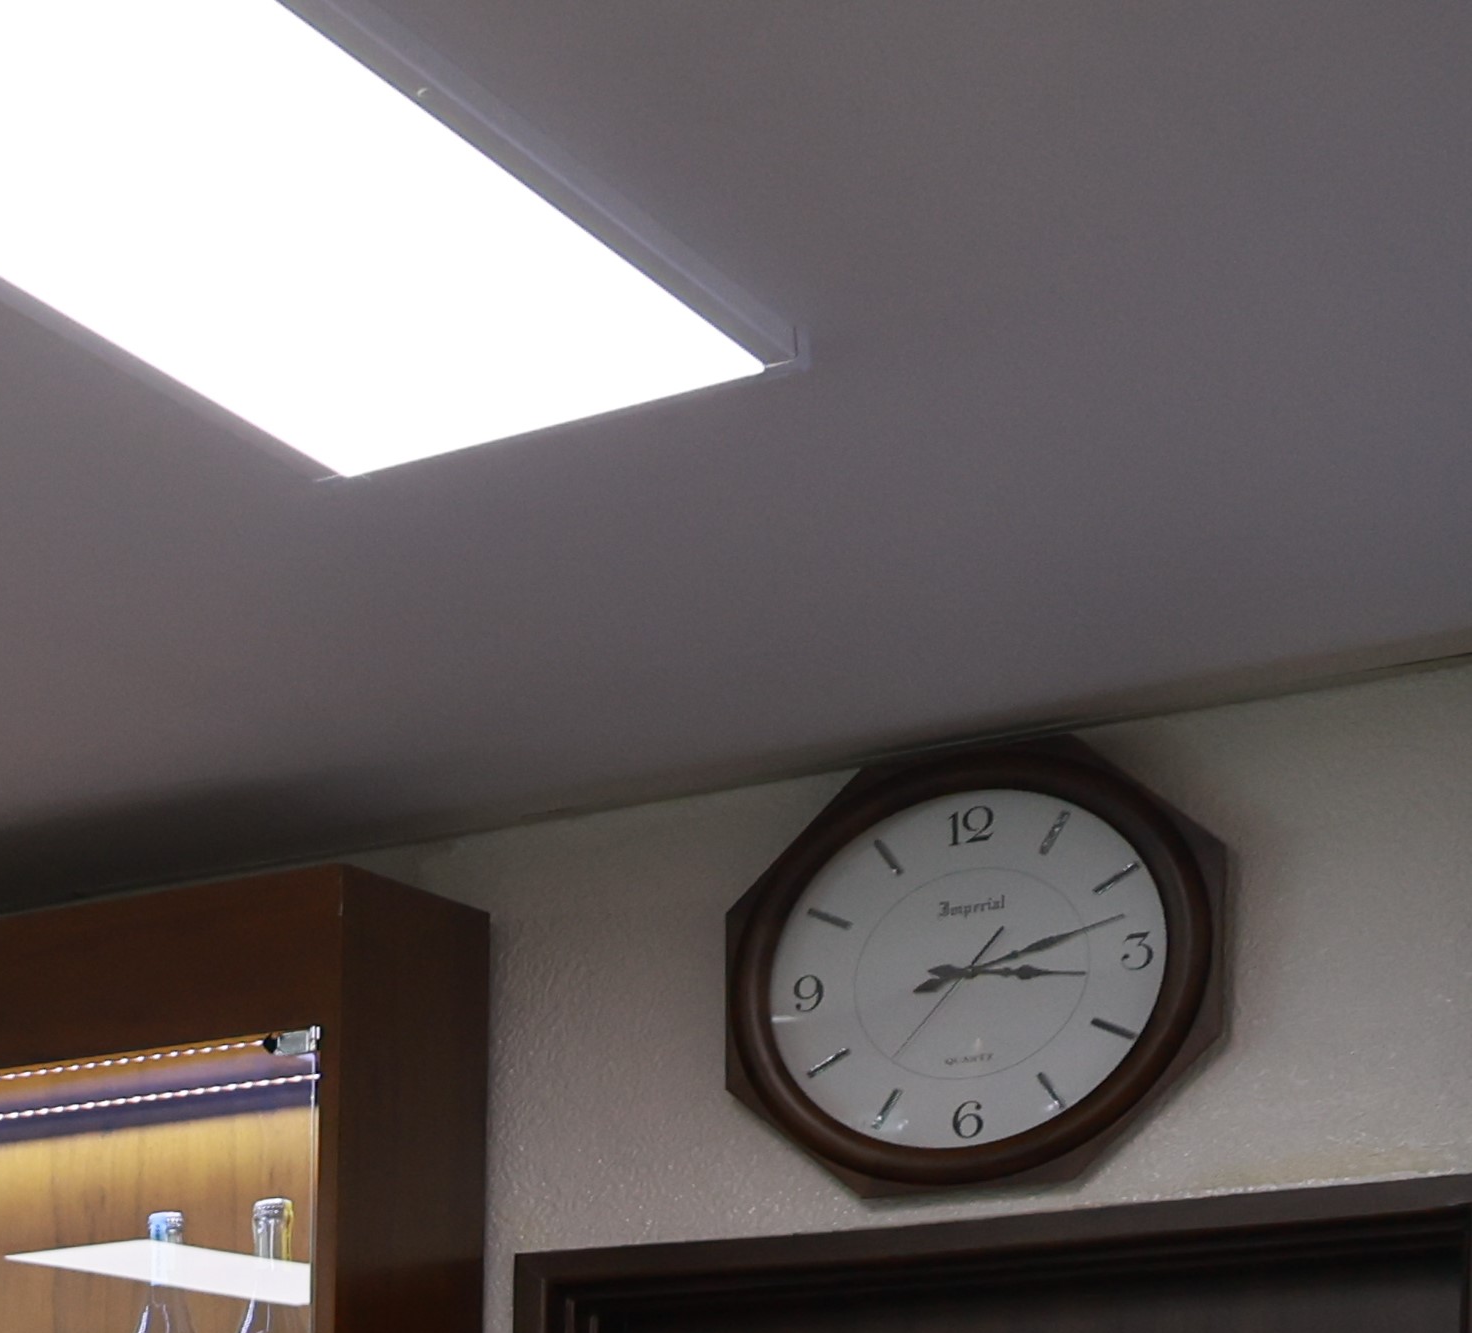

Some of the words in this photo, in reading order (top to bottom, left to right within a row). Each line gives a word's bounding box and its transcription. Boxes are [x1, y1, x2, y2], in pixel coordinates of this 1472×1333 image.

[947, 805, 995, 847] 12
[938, 895, 1006, 918] Imperial
[1121, 932, 1154, 970] 3
[794, 974, 824, 1012] 9
[945, 1052, 994, 1066] QUARTZ
[952, 1100, 984, 1139] 6
